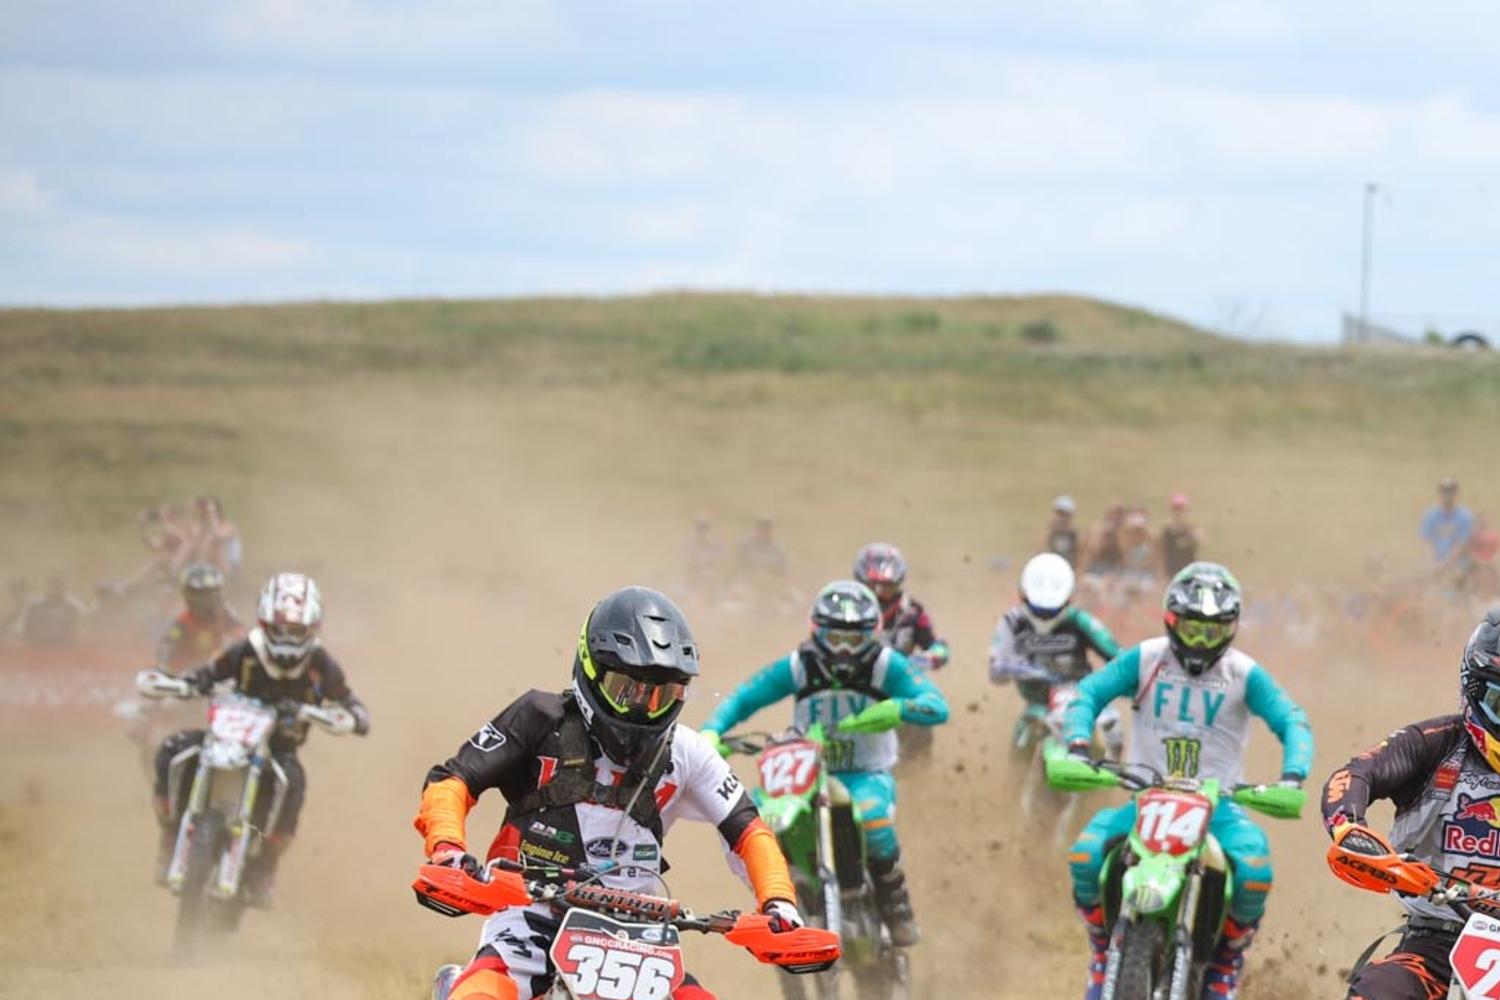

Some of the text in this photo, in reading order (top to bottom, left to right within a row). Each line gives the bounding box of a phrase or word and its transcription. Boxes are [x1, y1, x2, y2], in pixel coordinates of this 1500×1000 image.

[1153, 682, 1226, 729] FLY
[761, 749, 816, 792] 127
[1139, 800, 1207, 847] 114
[552, 850, 571, 864] Ice
[1445, 824, 1497, 857] Red
[1336, 855, 1397, 884] ACERBIS
[573, 889, 669, 913] RENTHAL
